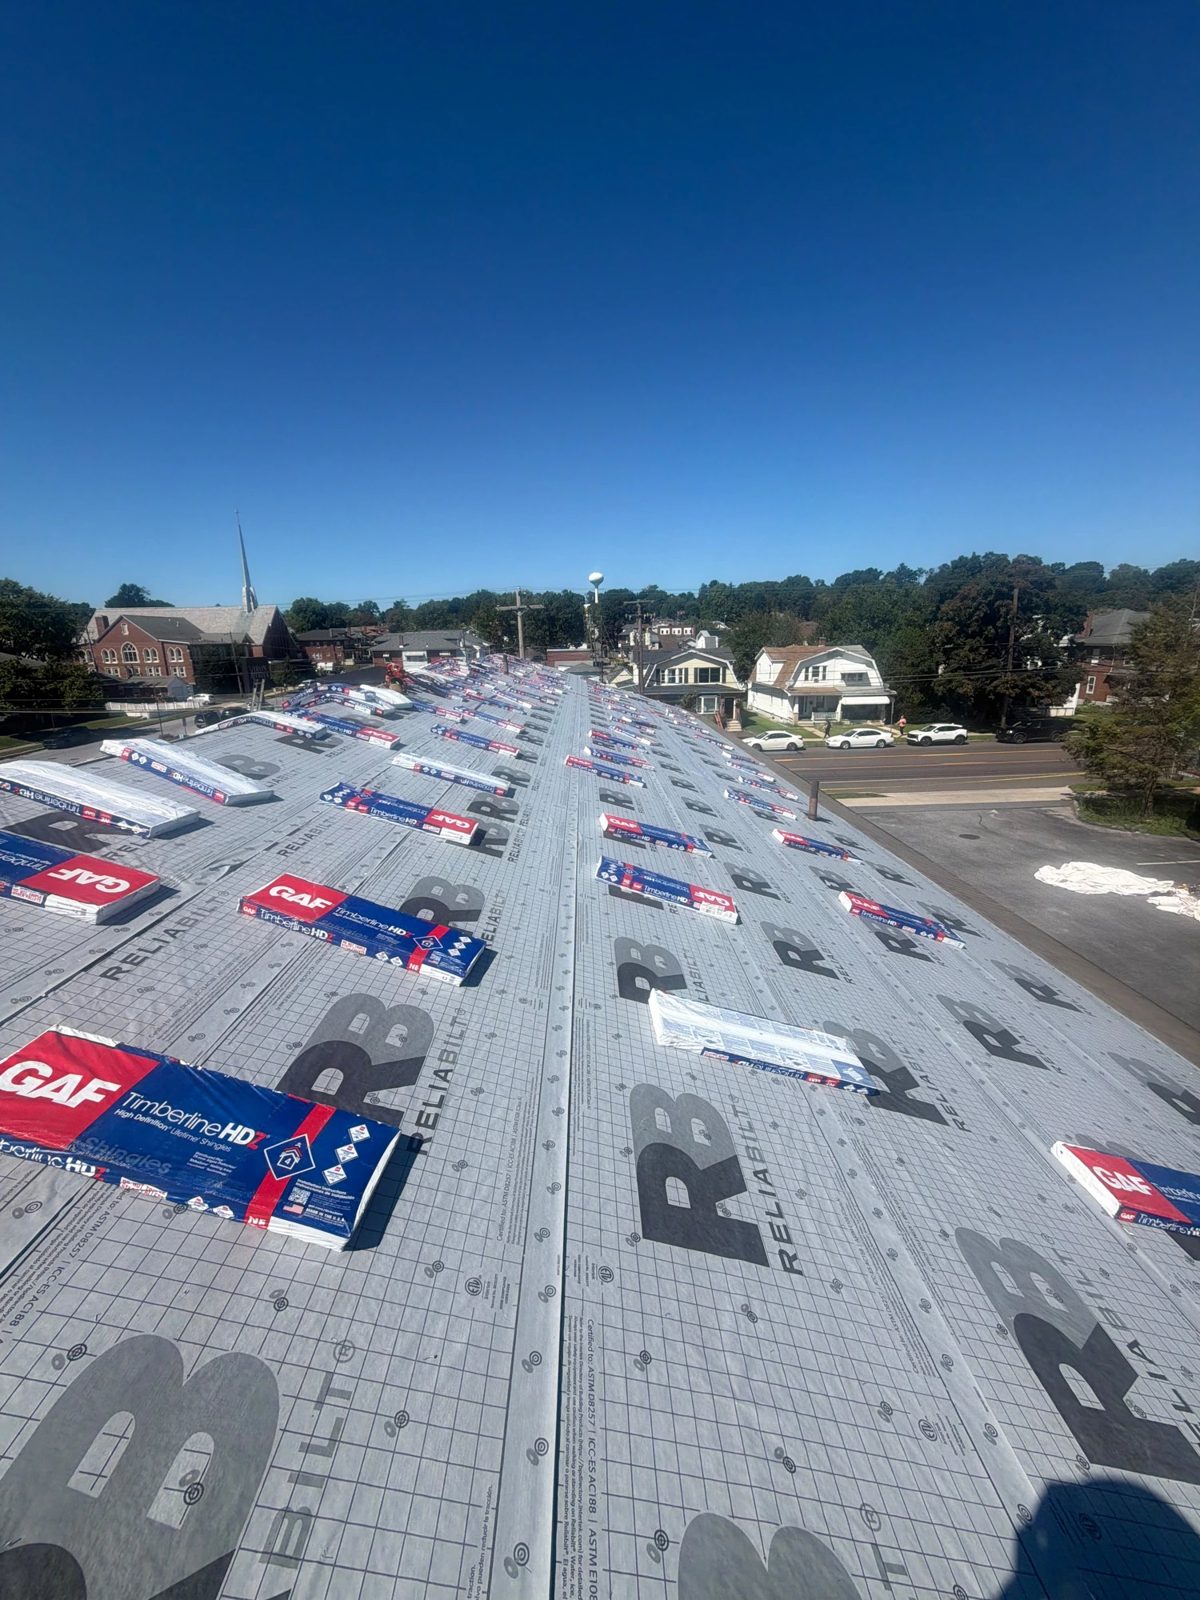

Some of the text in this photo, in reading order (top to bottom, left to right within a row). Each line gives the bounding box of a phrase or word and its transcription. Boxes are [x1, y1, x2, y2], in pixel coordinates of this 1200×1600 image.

[432, 814, 470, 828] GAF
[48, 868, 130, 893] GAF
[269, 886, 332, 909] GAF
[694, 891, 730, 906] GAF
[243, 906, 257, 915] GAF
[260, 908, 311, 935] Timberline
[335, 907, 389, 930] Timberline
[0, 1061, 122, 1108] GAF
[122, 1092, 222, 1136] Timberline
[114, 1109, 134, 1119] High
[200, 1138, 231, 1152] Shingles
[1092, 1166, 1152, 1196] GAF
[89, 1211, 108, 1234] ASTM
[1138, 1214, 1188, 1234] Timberline
[68, 1232, 94, 1259] D8257
[36, 1266, 67, 1297] ICC-ES
[9, 1294, 39, 1328] AC188
[588, 1437, 596, 1473] ICC-ES
[588, 1474, 597, 1514] AC188
[477, 1551, 485, 1585] pueden
[485, 1485, 493, 1515] tracción.
[589, 1528, 597, 1567] ASTM
[467, 1564, 475, 1599] traction.
